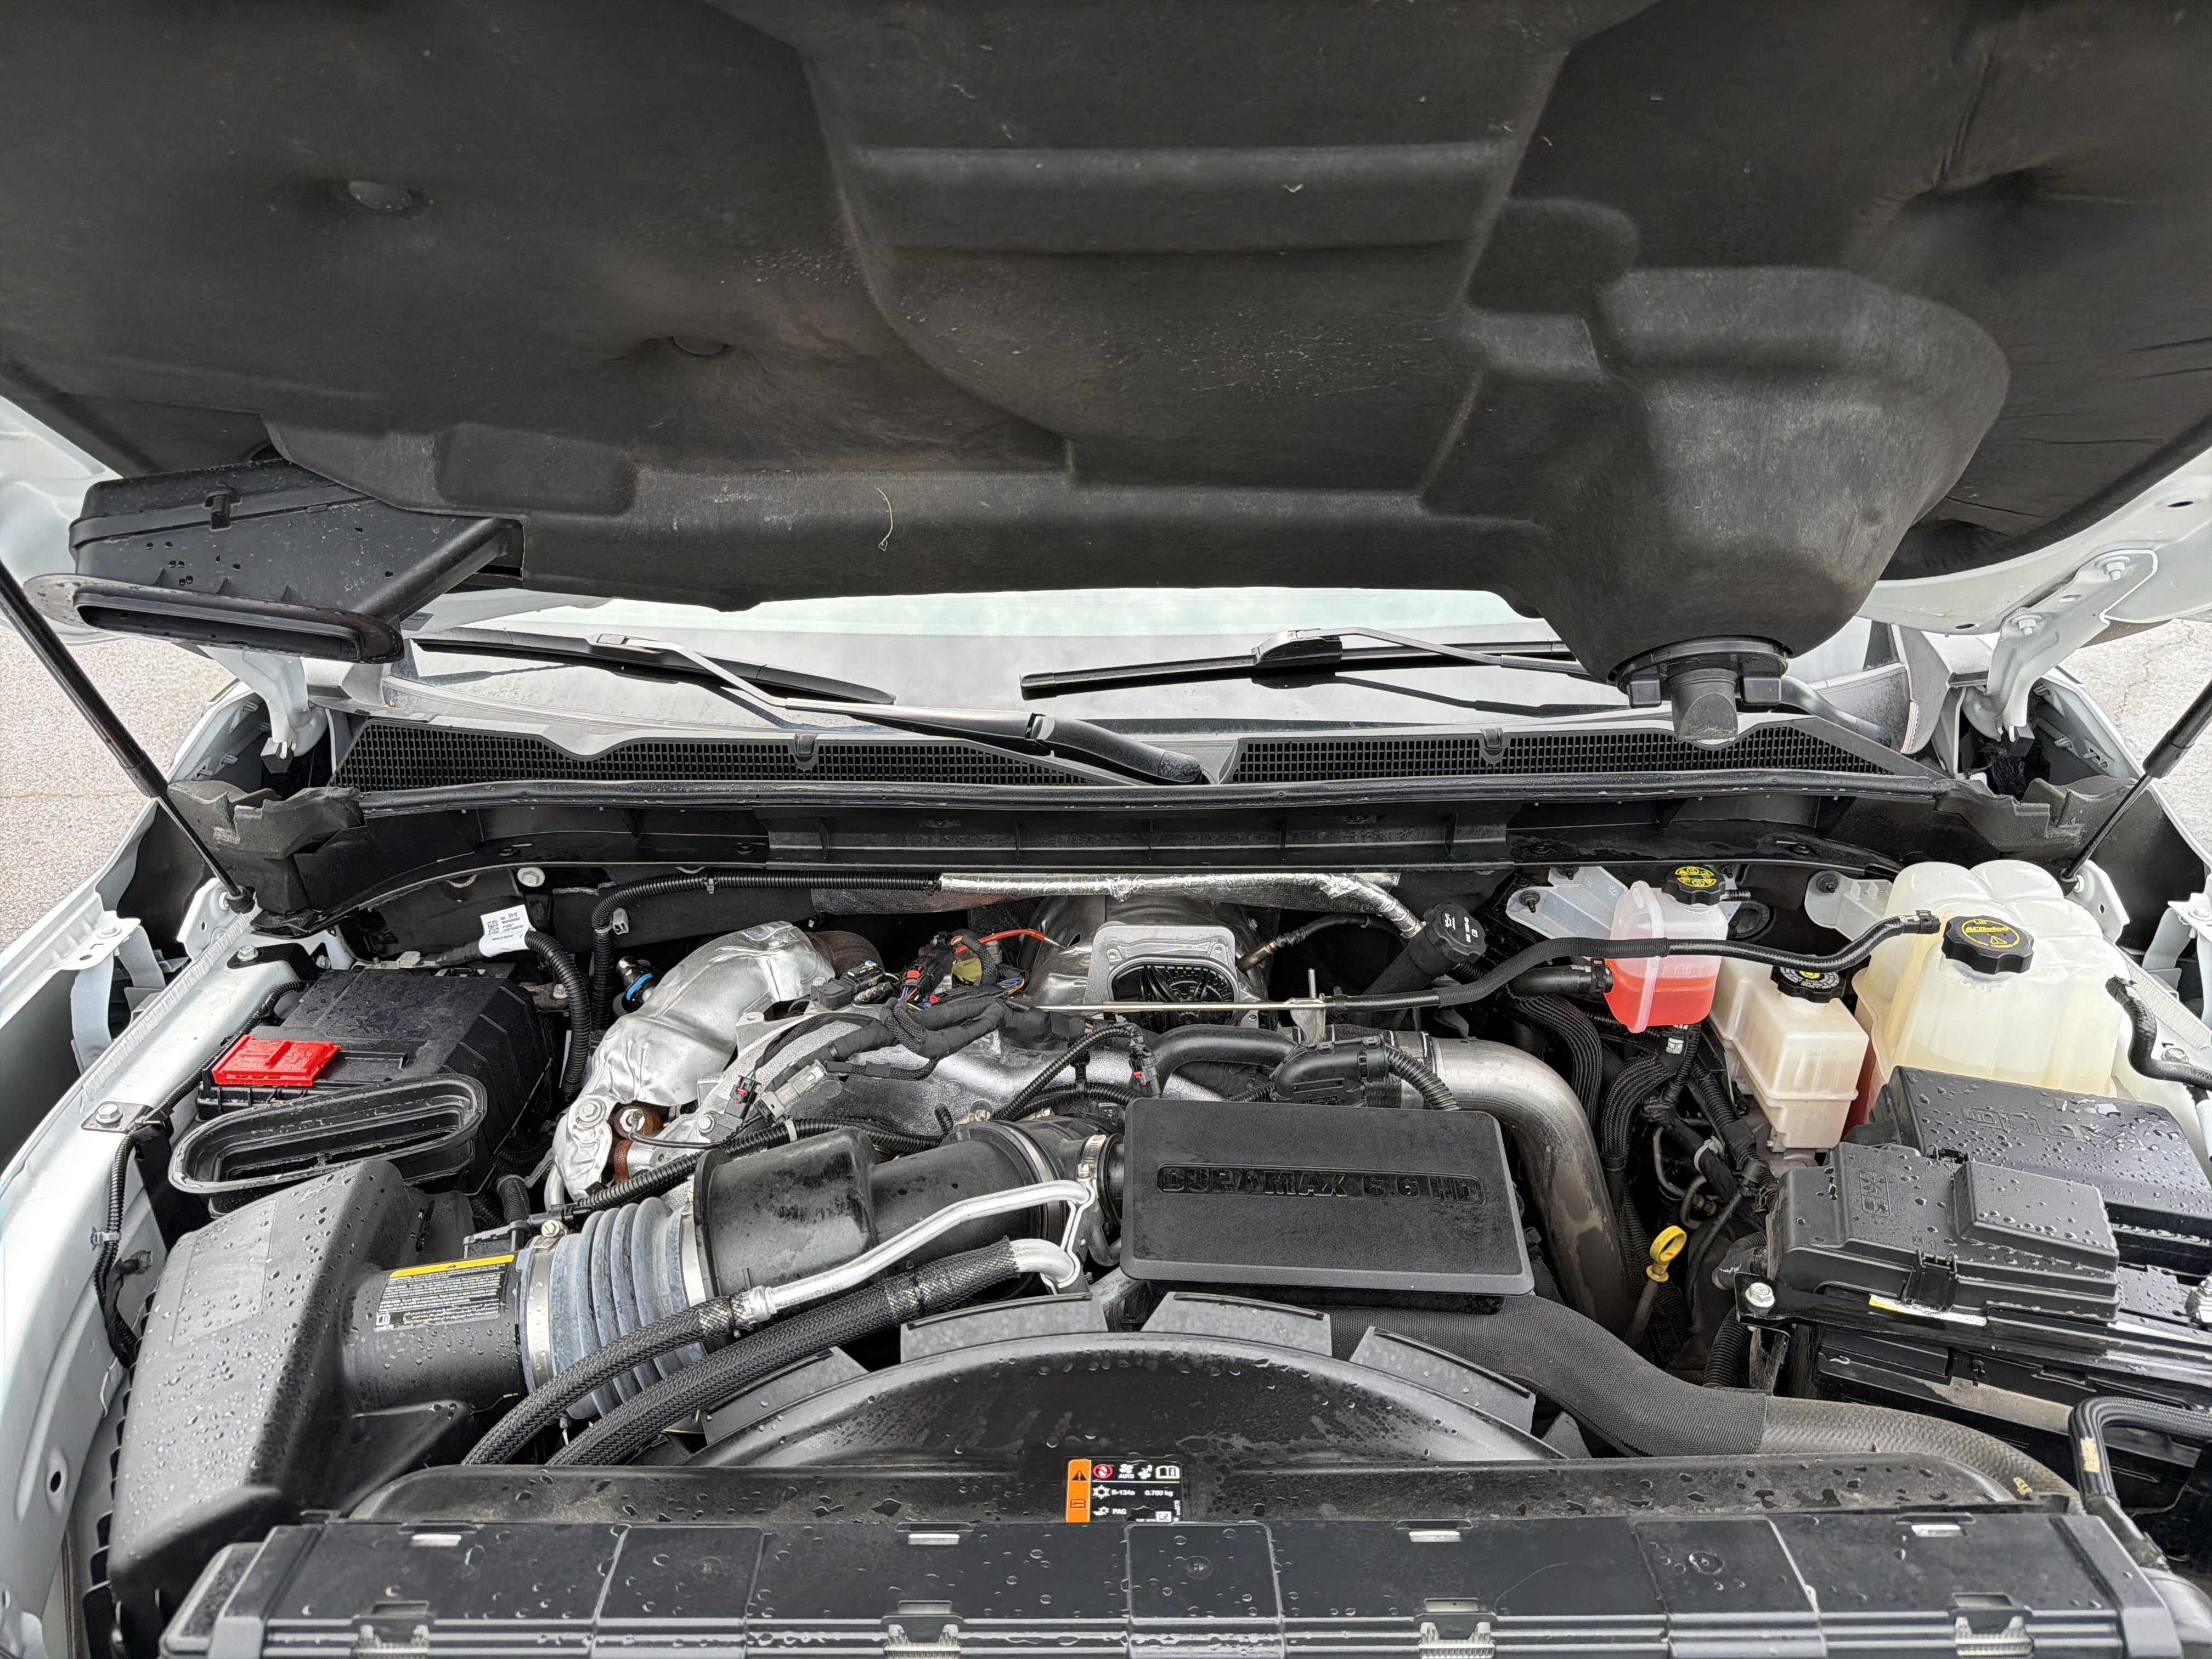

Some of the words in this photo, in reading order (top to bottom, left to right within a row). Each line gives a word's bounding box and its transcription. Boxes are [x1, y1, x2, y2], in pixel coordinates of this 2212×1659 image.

[1163, 1167, 1347, 1197] DURAMAX
[1362, 1173, 1420, 1199] 6.6
[1428, 1176, 1479, 1203] HD
